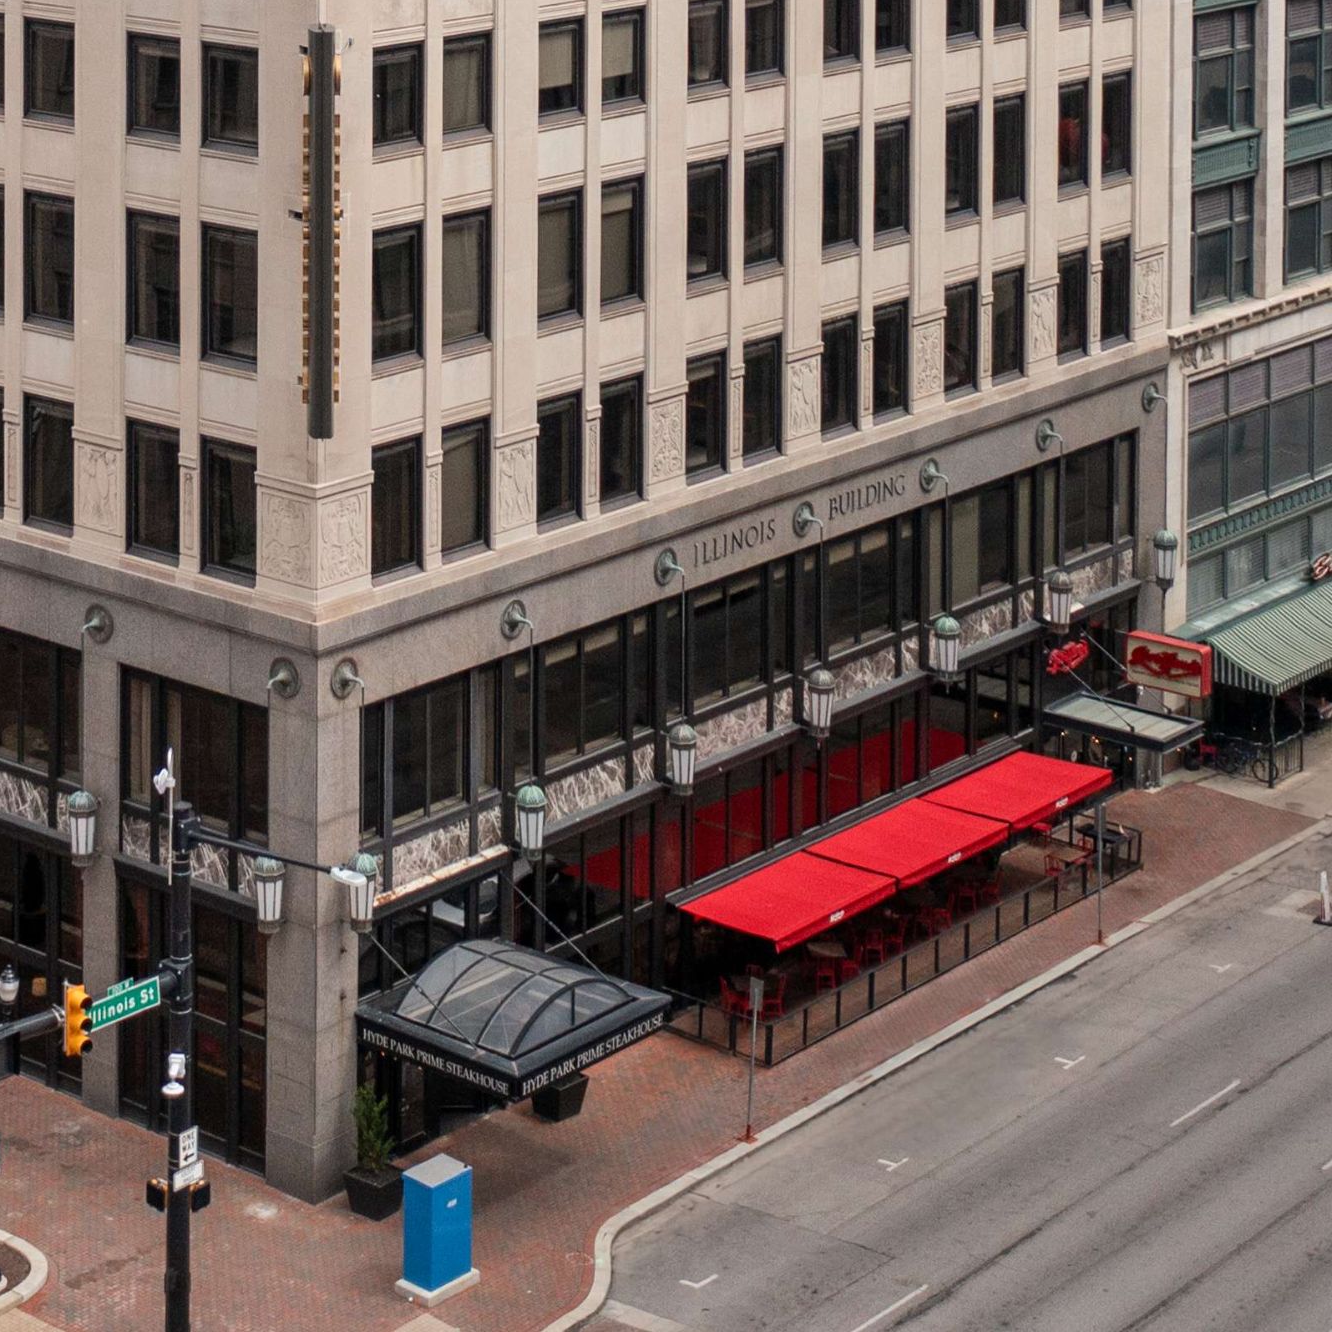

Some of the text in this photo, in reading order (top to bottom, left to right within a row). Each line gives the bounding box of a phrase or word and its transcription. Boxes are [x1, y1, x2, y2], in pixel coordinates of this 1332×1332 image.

[693, 474, 906, 568] ILLINOIS BUILDING
[140, 987, 154, 1004] St
[363, 1028, 509, 1096] HYDE PARK PRIME STEAKHOUSE
[522, 1013, 664, 1096] HYDE PARK PRIME STEAKHOUSE
[182, 1131, 195, 1143] ONE
[182, 1140, 195, 1152] WAY
